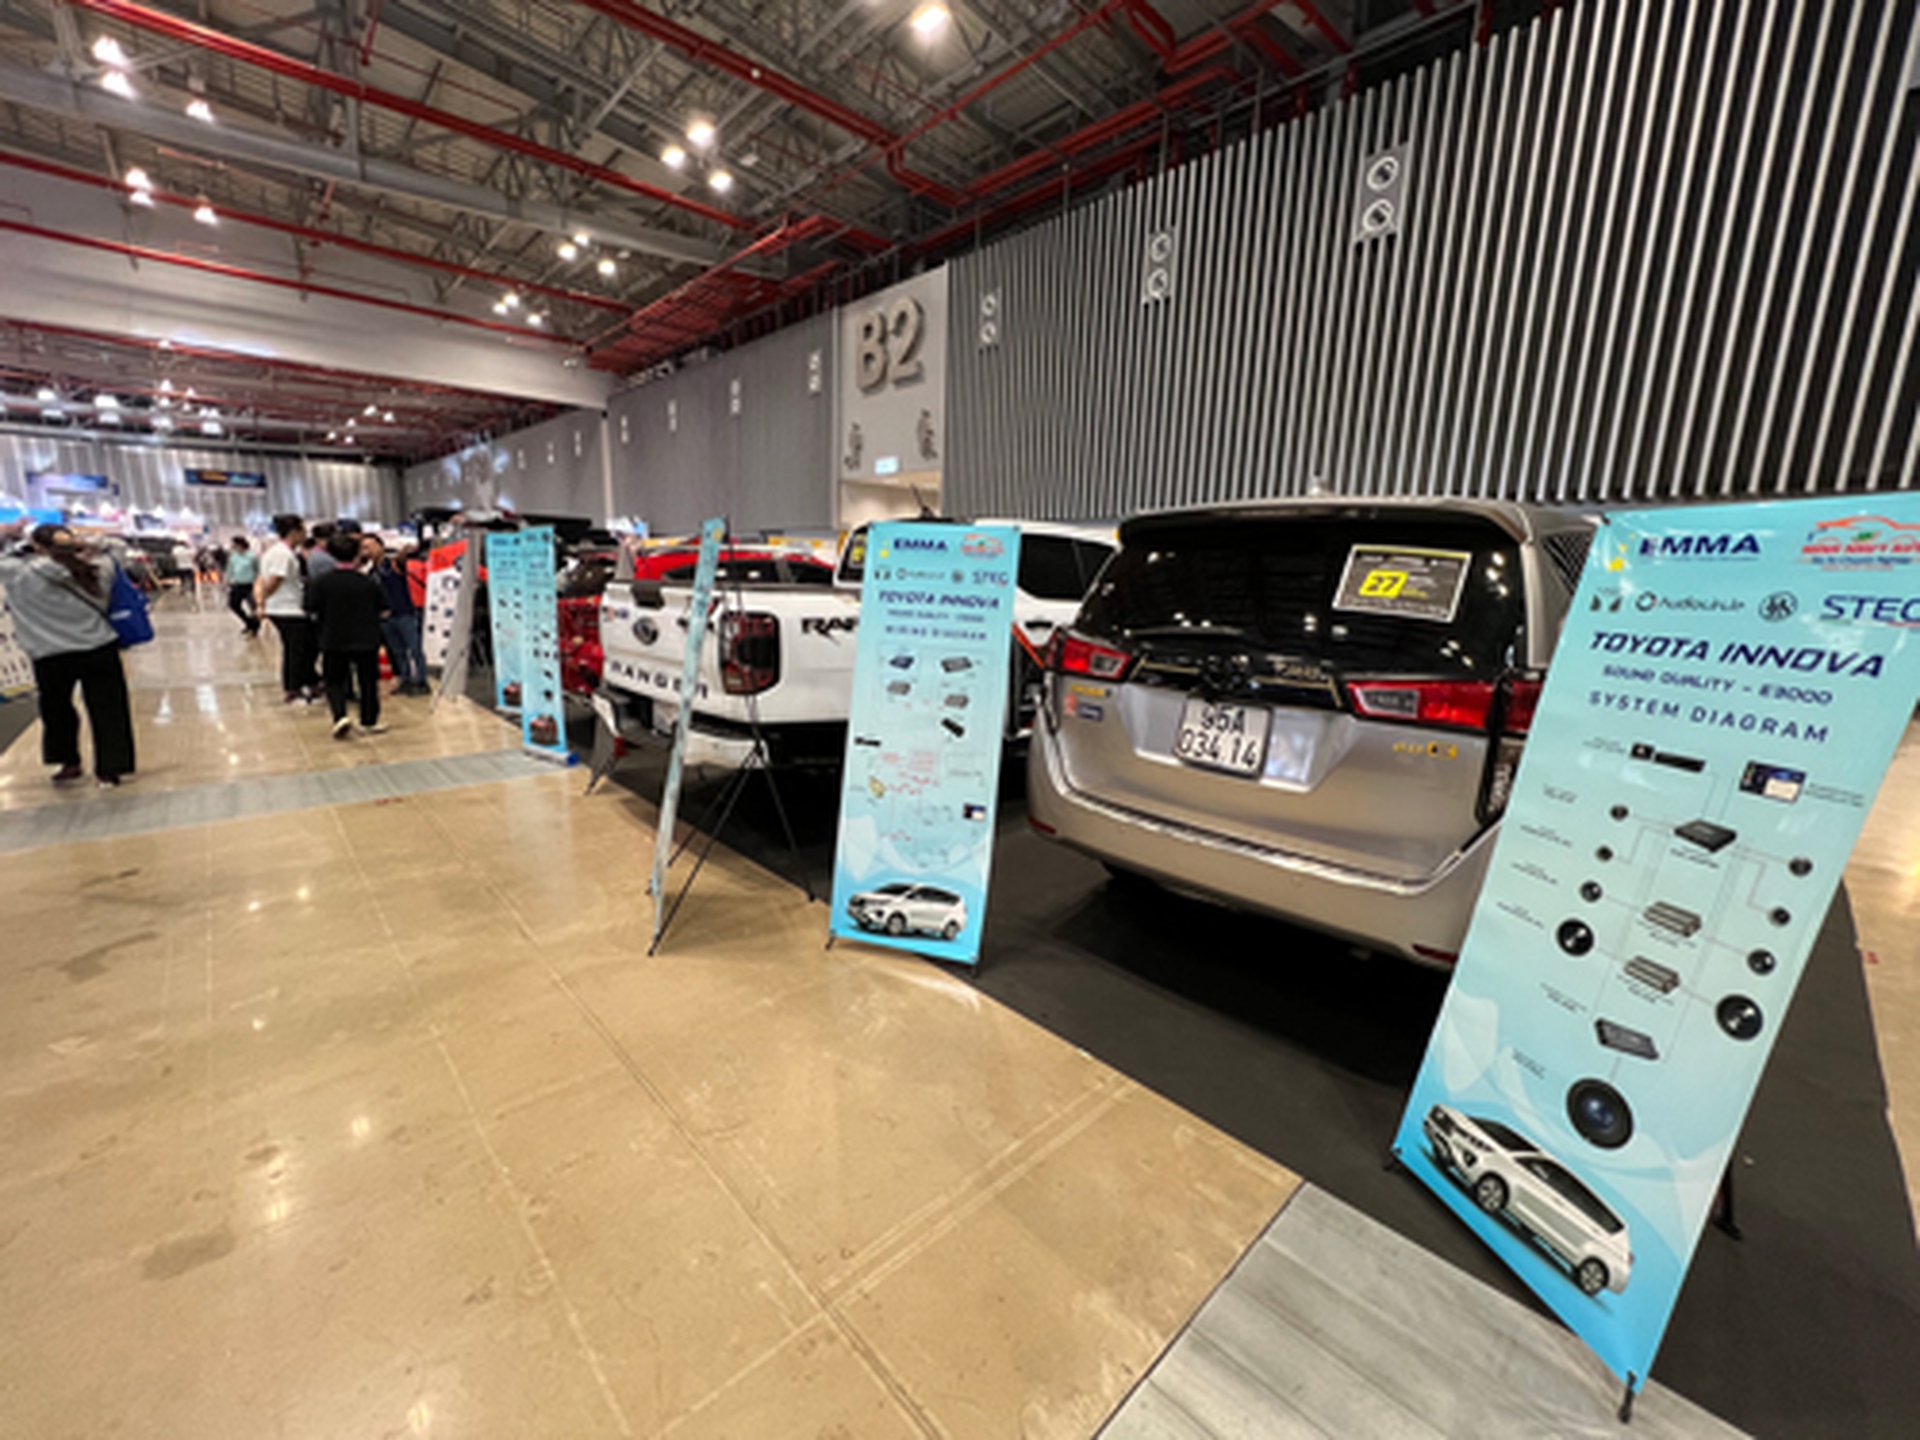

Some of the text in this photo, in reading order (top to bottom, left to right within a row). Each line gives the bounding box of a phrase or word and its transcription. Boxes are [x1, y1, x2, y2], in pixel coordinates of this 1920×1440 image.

[857, 298, 925, 395] B2
[893, 538, 947, 552] EMMA
[1639, 534, 1761, 555] EMMA
[1367, 575, 1400, 593] 27
[880, 590, 999, 611] TOYOTA INNOVA
[1591, 632, 1884, 678] TOYOTA INNOVA
[1603, 665, 1656, 683] SOUND
[1659, 671, 1737, 693] QUALITY
[1759, 684, 1834, 706] E3000
[1589, 690, 1830, 744] SYSTEM DIAGRAM
